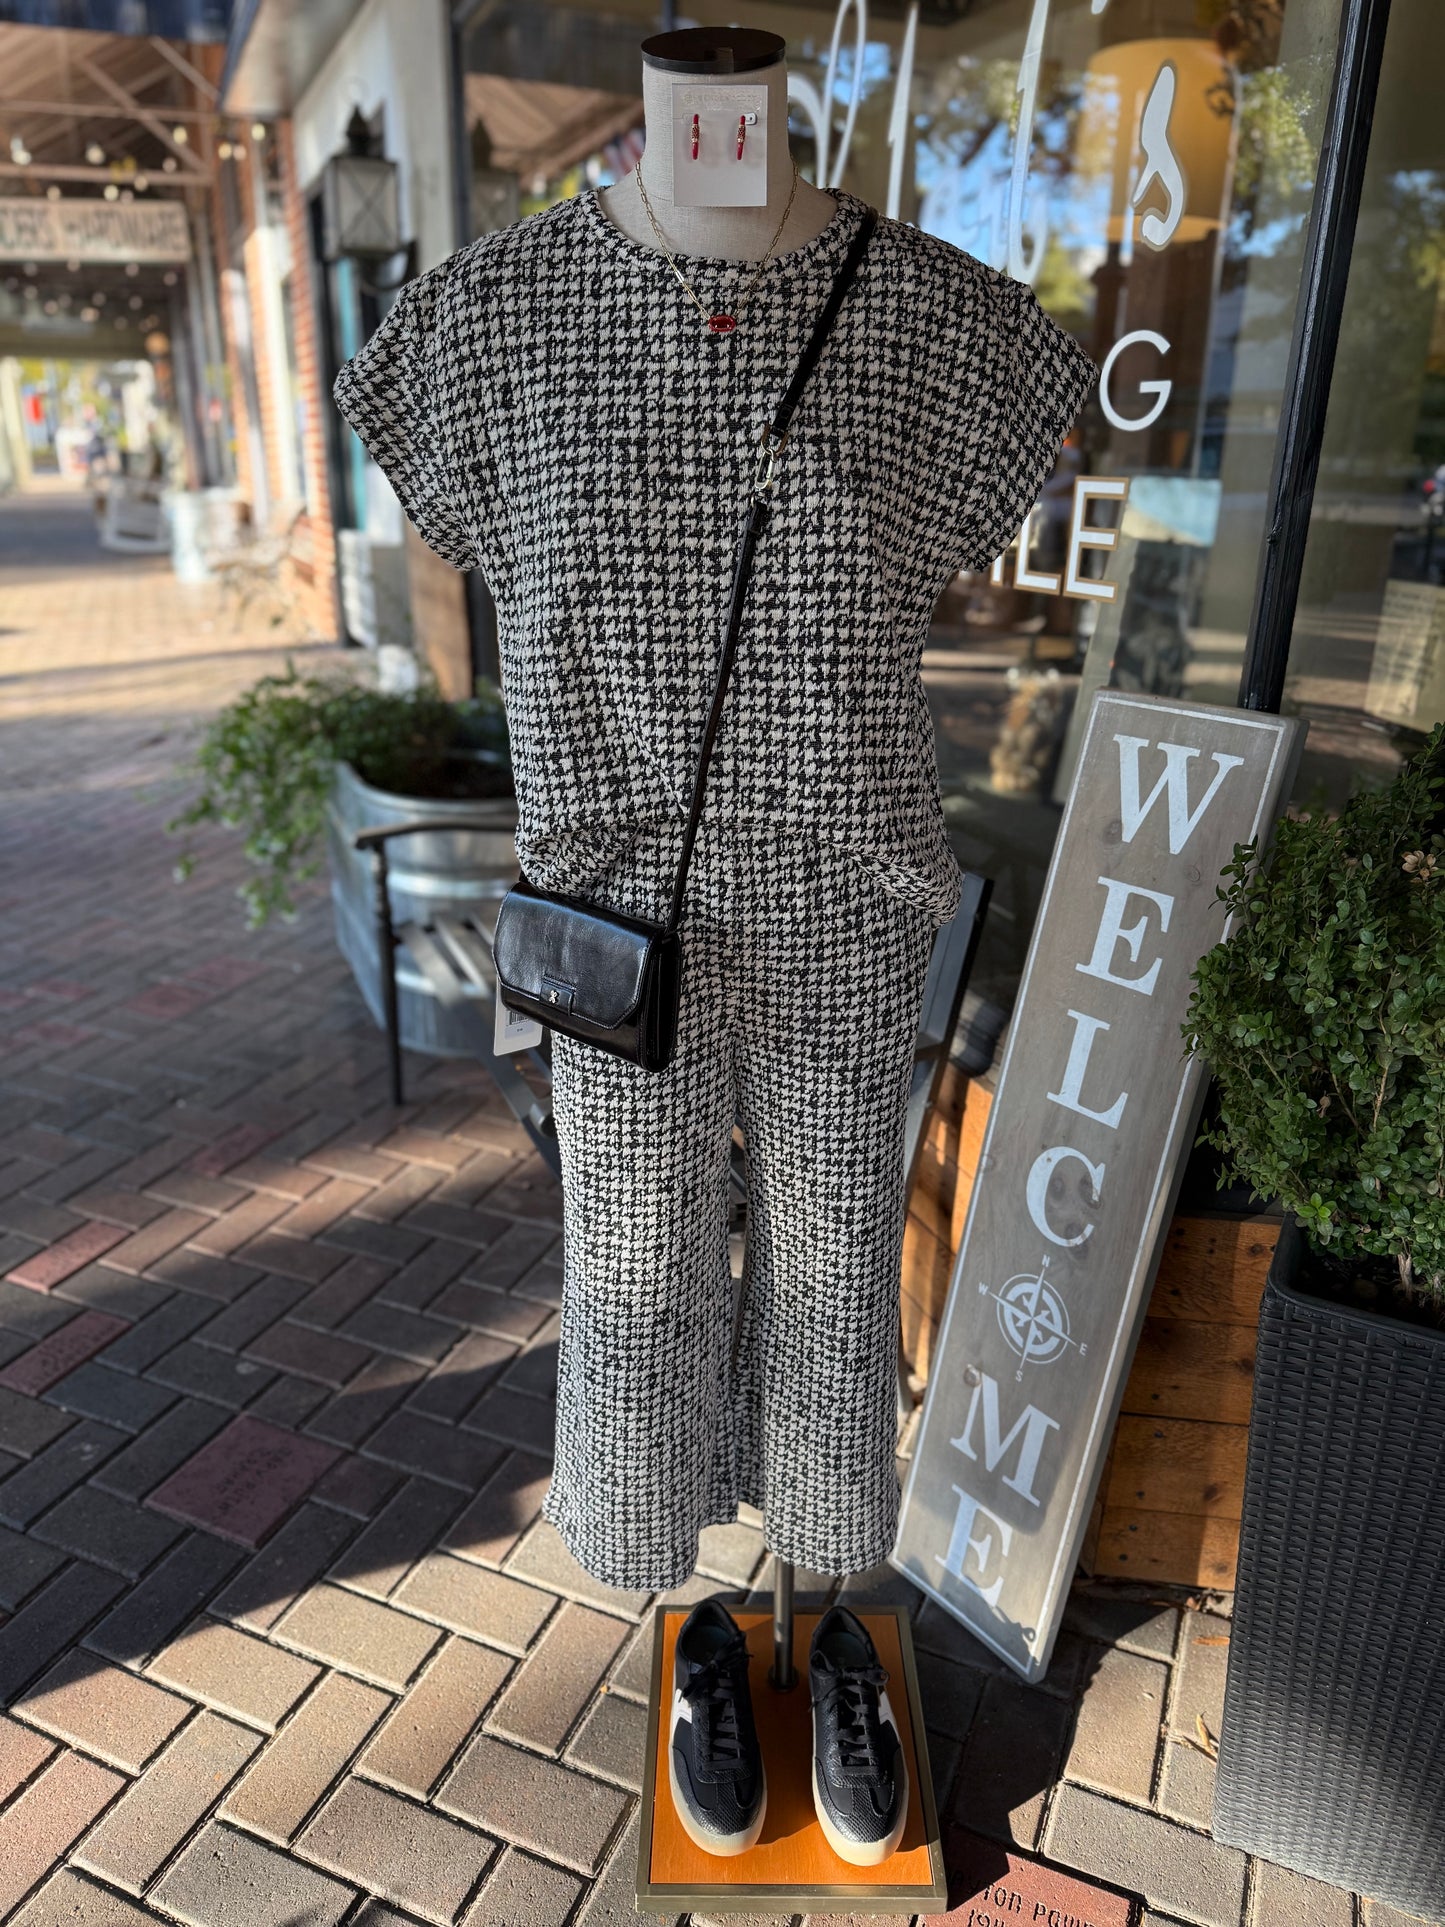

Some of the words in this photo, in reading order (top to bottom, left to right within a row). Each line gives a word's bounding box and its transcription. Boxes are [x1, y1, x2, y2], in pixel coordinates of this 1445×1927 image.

[1041, 1254, 1051, 1267] N
[978, 1282, 989, 1296] W
[1079, 1342, 1089, 1356] E
[1015, 1370, 1024, 1382] S
